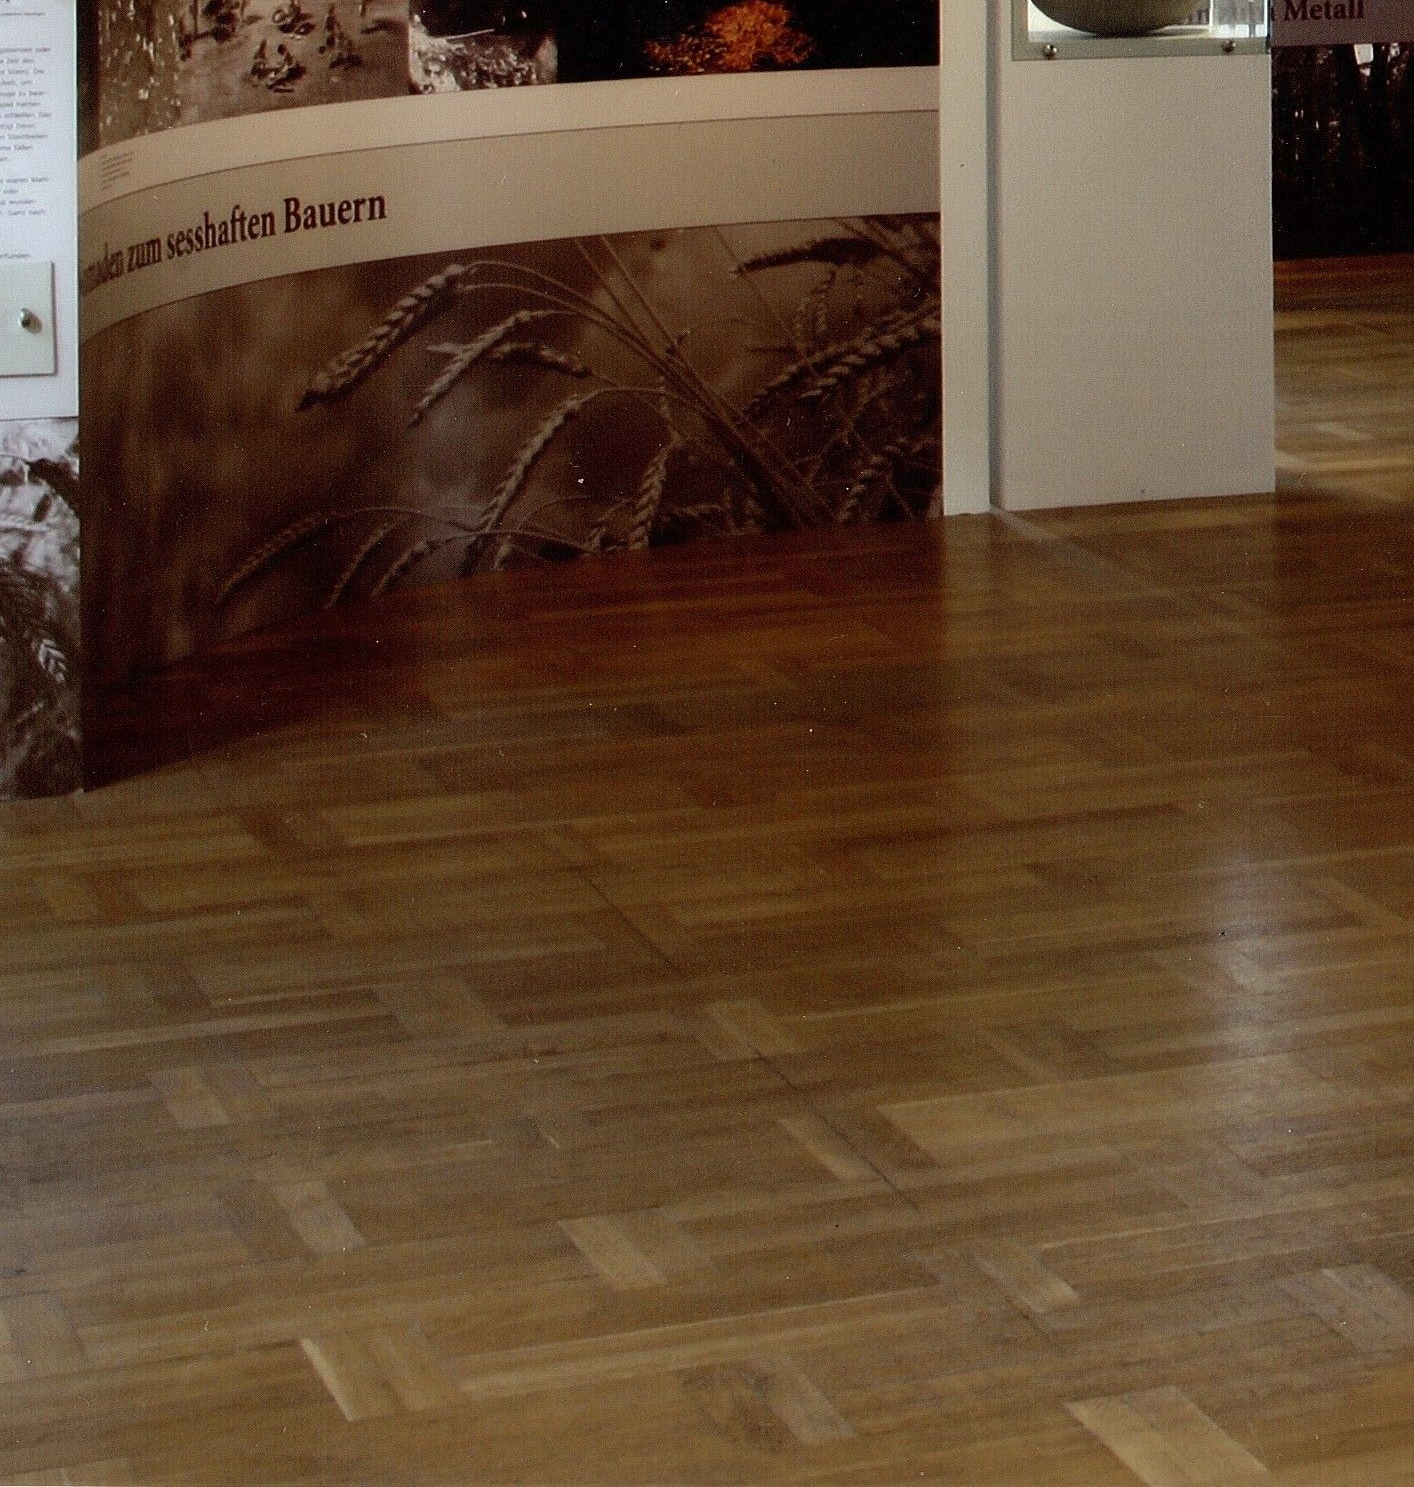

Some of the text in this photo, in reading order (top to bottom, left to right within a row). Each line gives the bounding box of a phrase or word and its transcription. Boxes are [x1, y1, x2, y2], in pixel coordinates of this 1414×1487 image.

[127, 237, 162, 274] zum
[166, 204, 276, 261] sesshaften
[283, 195, 387, 234] Bauern
